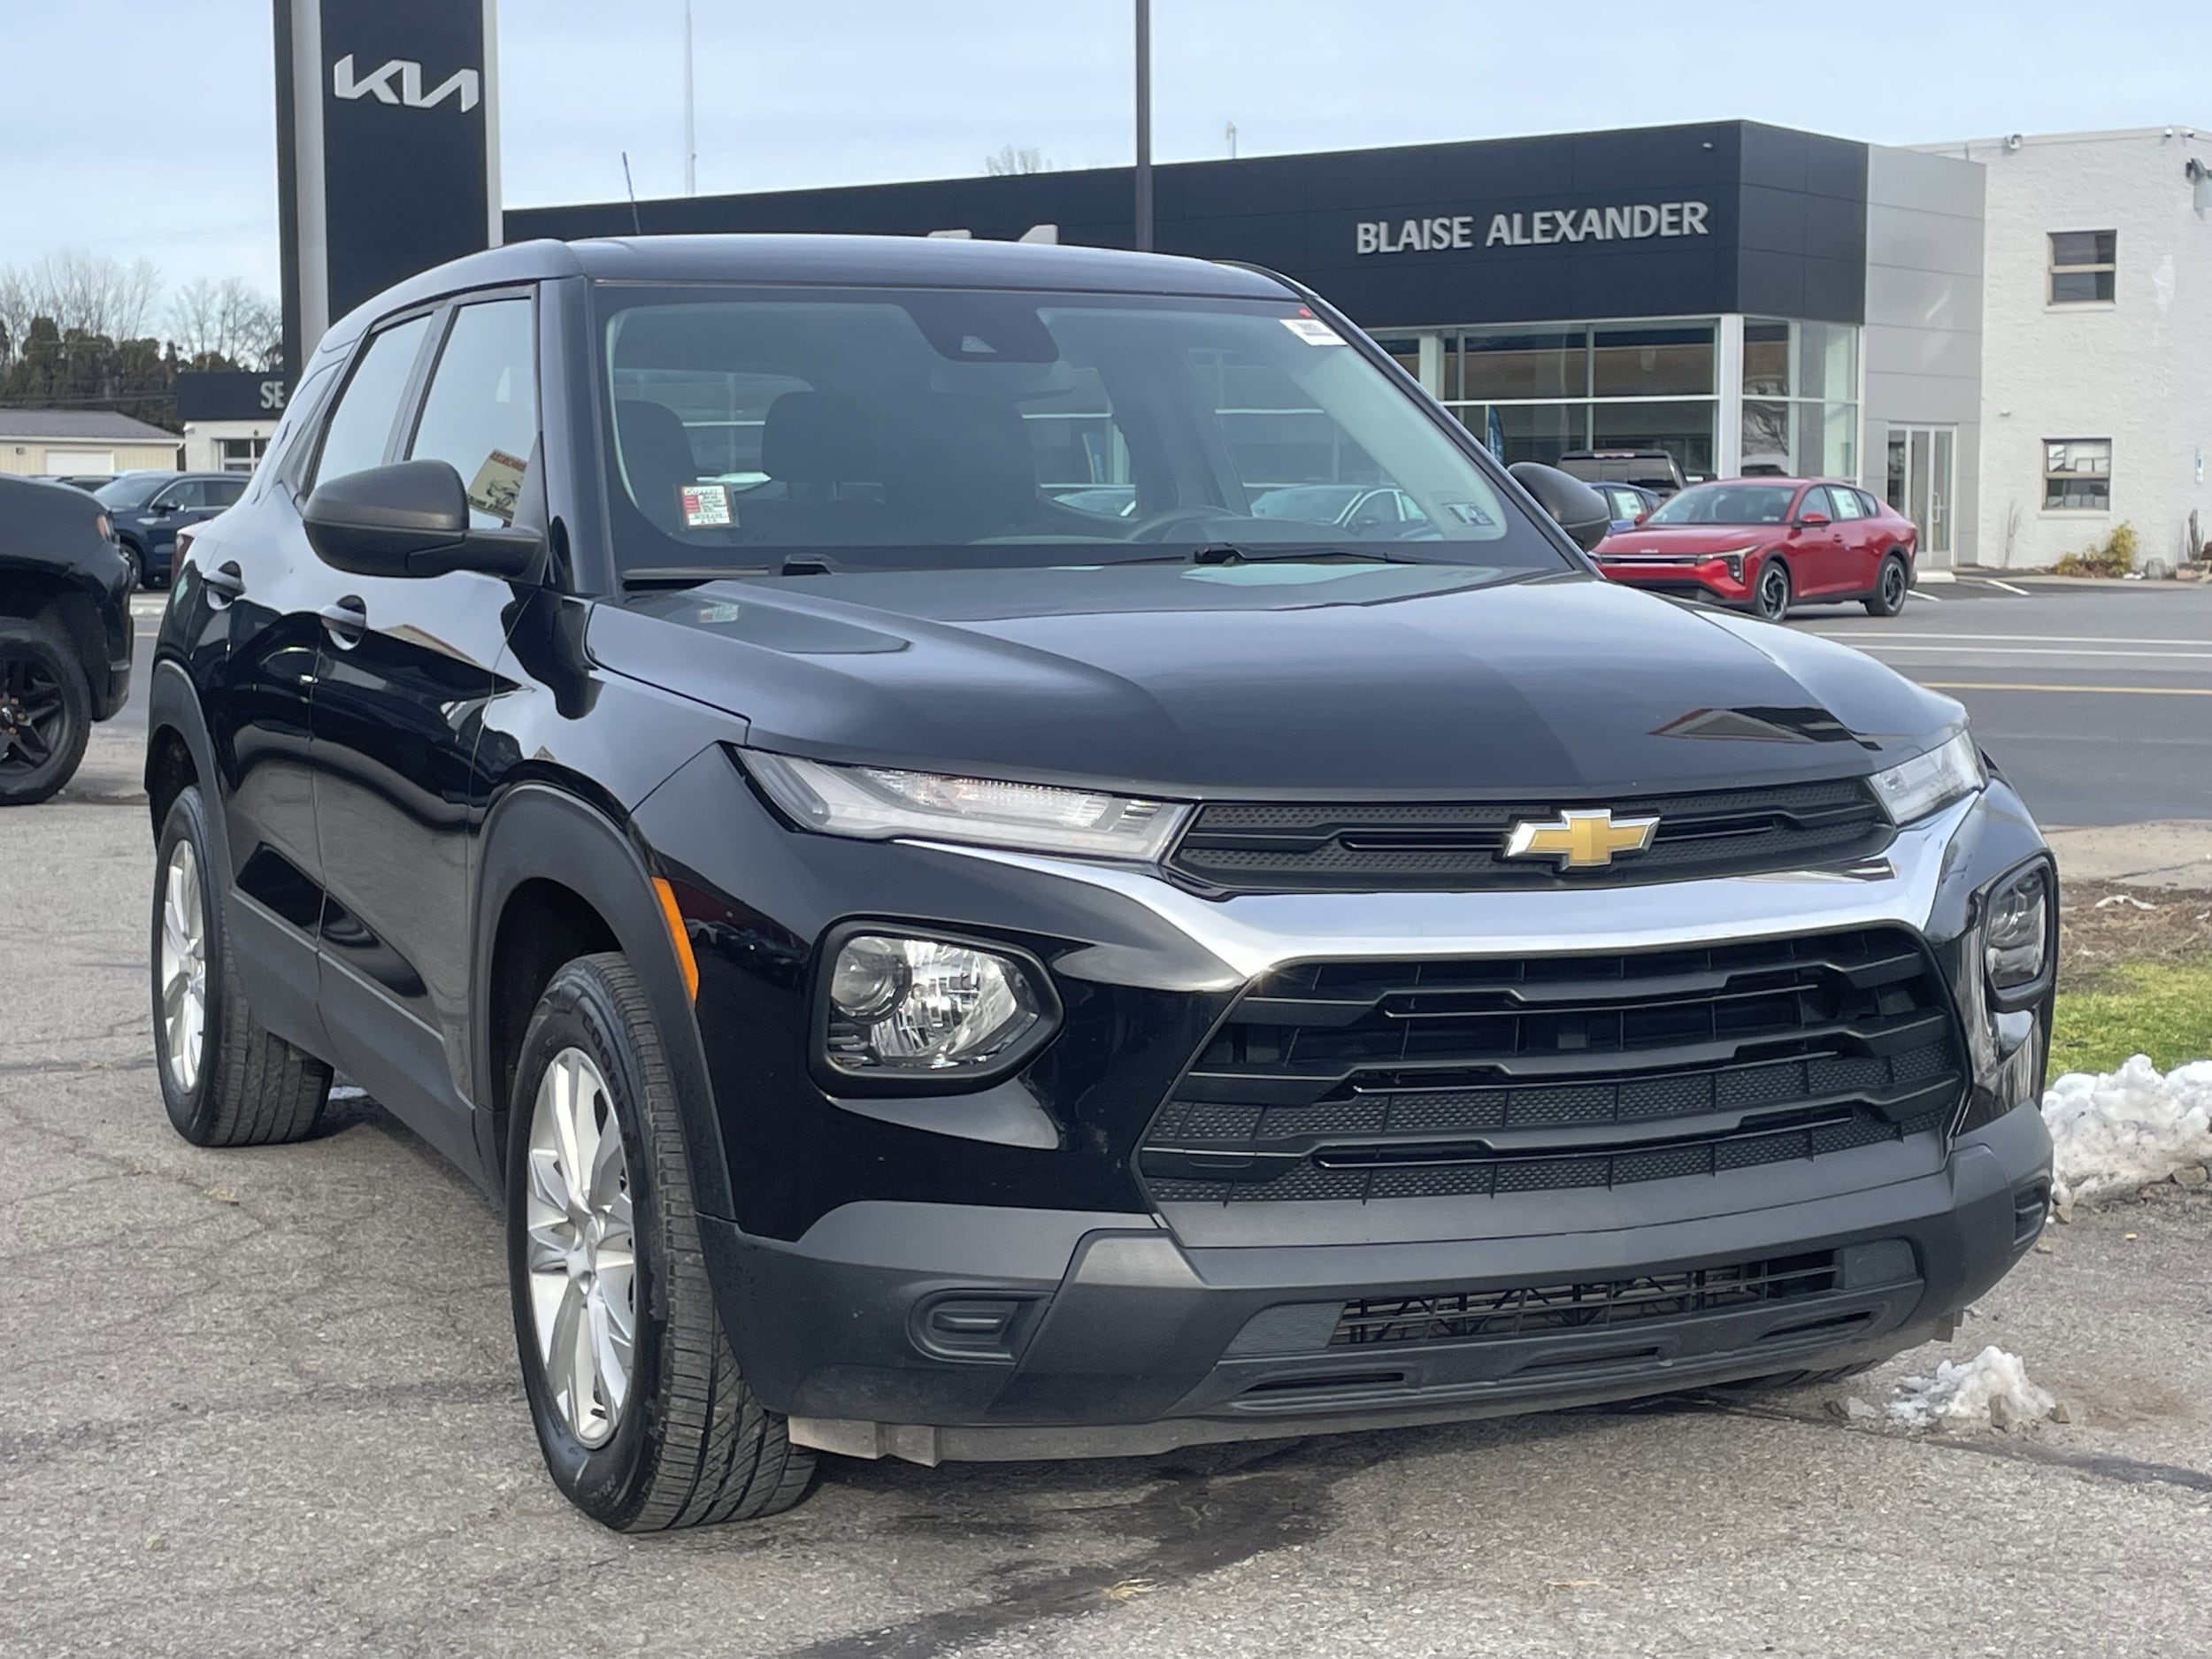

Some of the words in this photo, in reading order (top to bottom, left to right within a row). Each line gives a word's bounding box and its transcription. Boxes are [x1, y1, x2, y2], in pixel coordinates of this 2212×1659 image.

[334, 53, 480, 113] KIA
[1356, 216, 1473, 254] BLAISE
[1486, 201, 1709, 247] ALEXANDER
